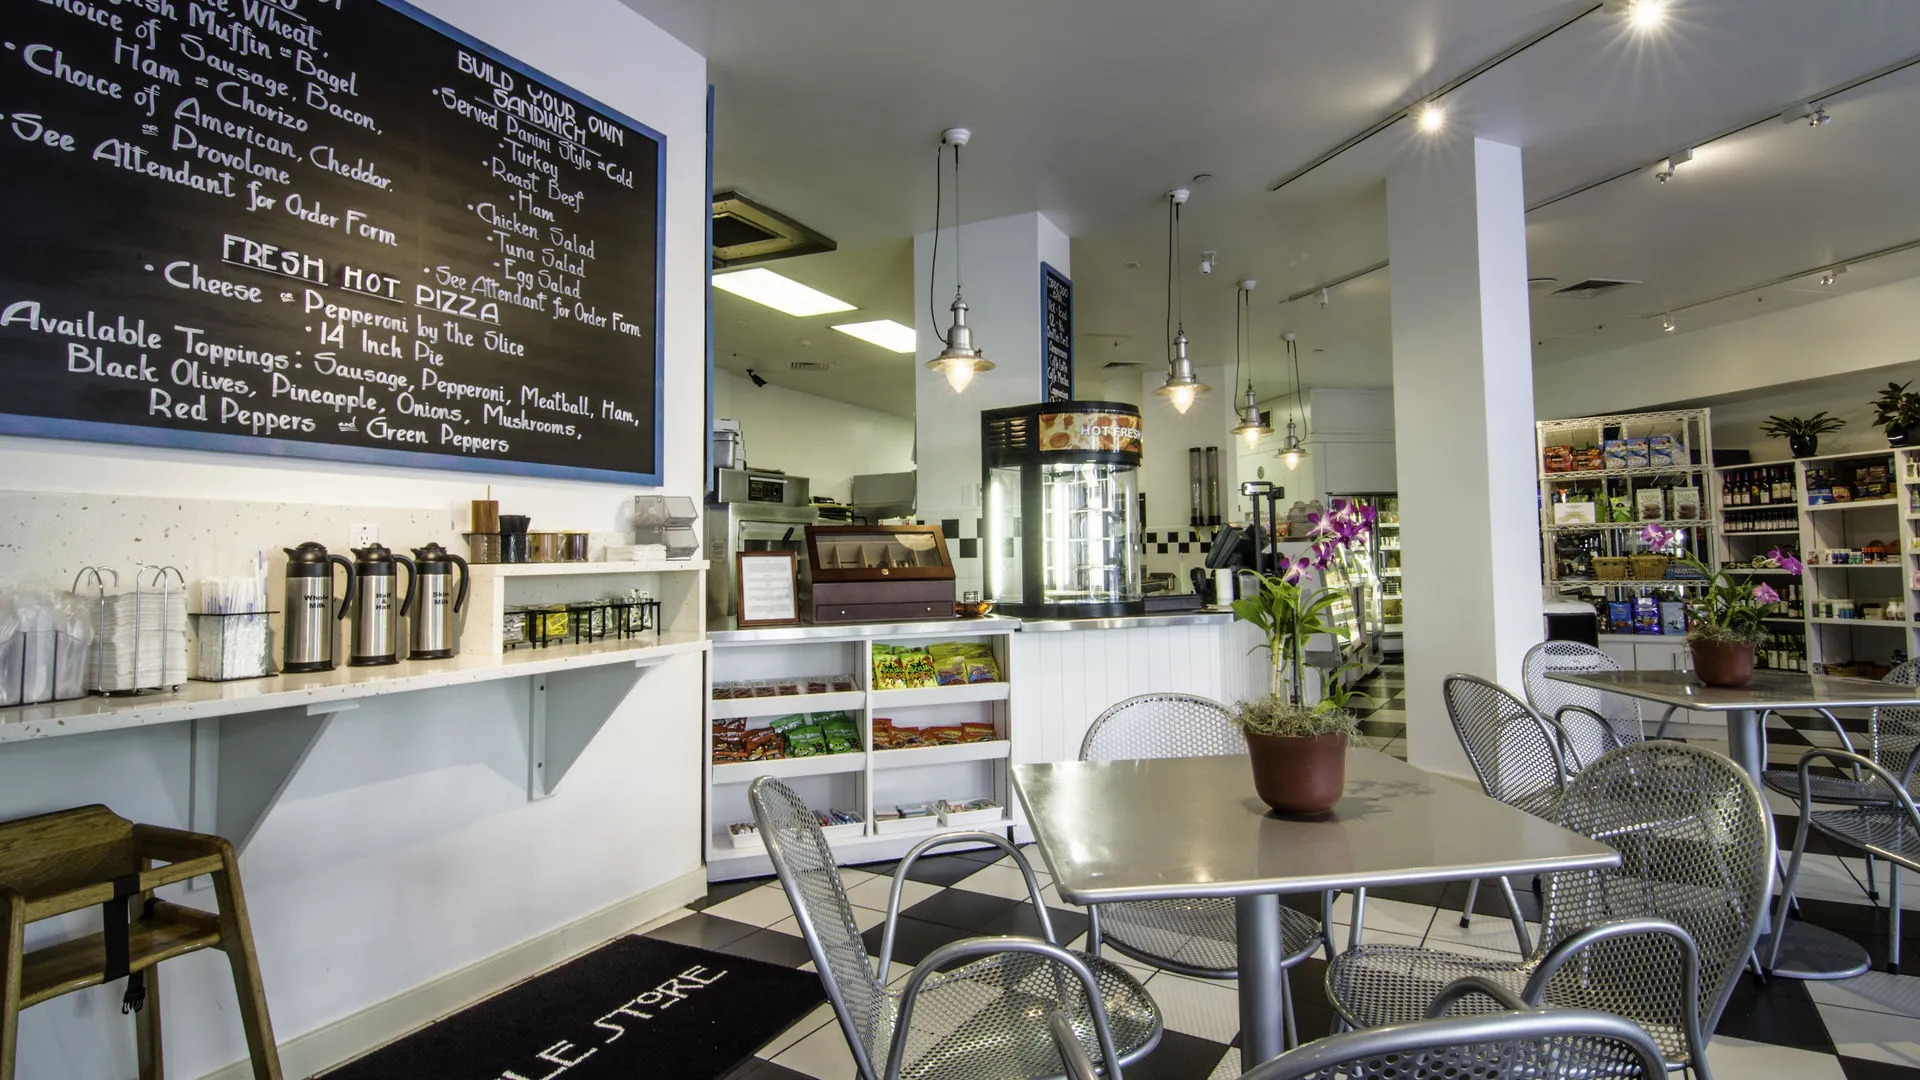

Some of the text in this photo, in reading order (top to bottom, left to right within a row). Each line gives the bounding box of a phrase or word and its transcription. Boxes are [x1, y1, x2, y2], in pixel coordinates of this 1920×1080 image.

[189, 2, 272, 59] Muffin
[296, 49, 358, 96] Bagel
[242, 0, 328, 58] Wheat.
[24, 44, 122, 99] Choice
[134, 85, 160, 116] of
[174, 97, 302, 162] American,
[114, 37, 181, 86] Ham
[217, 81, 308, 131] Chorizo
[136, 19, 162, 49] of
[181, 34, 297, 102] Sausage,
[306, 82, 383, 135] Bacon,
[458, 50, 624, 147] BUILD YOUR OWN
[441, 87, 499, 130] Served
[506, 115, 551, 153] Panini
[558, 141, 592, 170] Style
[606, 163, 633, 188] Cold
[493, 89, 586, 145] SANDWICH
[12, 113, 398, 246] See Attendant for Order Form
[173, 124, 290, 184] Provolone
[492, 156, 584, 212] Roast Beef
[503, 137, 558, 181] Turkey
[476, 202, 596, 260] Chicken Salad
[519, 190, 555, 222] Ham
[223, 234, 499, 323] FRESH HOT PIZZA
[493, 230, 586, 278] Tuna Salad
[504, 258, 582, 299] Egg Salad
[164, 261, 262, 303] Cheese
[305, 289, 408, 333] Pepperoni
[417, 314, 438, 344] by
[443, 321, 474, 347] the
[484, 331, 525, 357] Slice
[436, 265, 641, 337] See Attendant for Order Form
[0, 301, 161, 349] Available
[314, 352, 414, 392] Sausage,
[422, 368, 511, 406] Pepperoni,
[521, 386, 594, 419] Meatball,
[602, 400, 639, 426] Ham,
[321, 321, 444, 366] 14 Inch Pie
[68, 342, 583, 439] Black Olives, Pineapple, Onions, Mushrooms,
[150, 388, 208, 421] Red
[221, 397, 316, 435] Peppers
[367, 417, 428, 444] Green
[441, 424, 509, 453] Peppers
[1080, 425, 1110, 437] HOT
